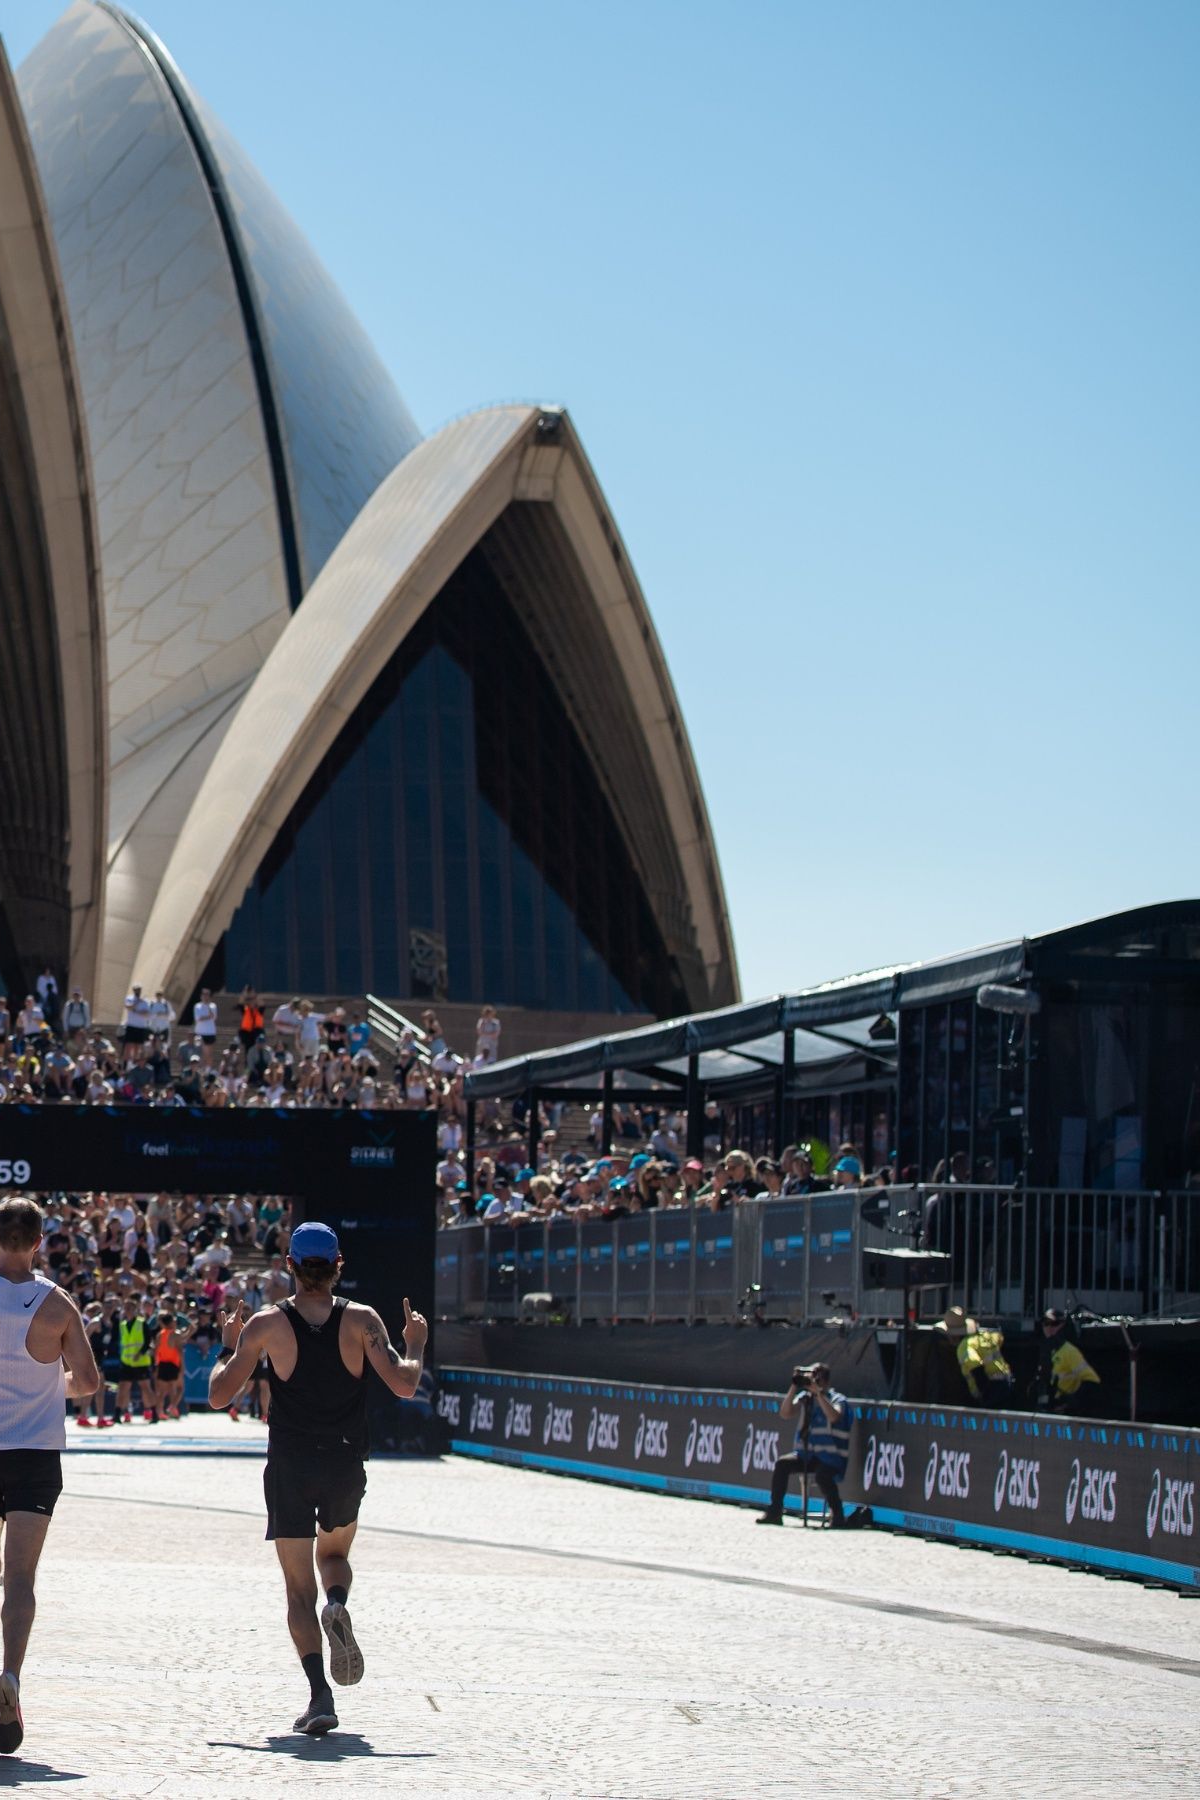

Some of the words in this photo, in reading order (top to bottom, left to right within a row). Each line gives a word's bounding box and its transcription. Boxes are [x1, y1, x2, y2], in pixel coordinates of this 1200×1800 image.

[142, 1142, 169, 1156] feel
[350, 1146, 395, 1159] SYDNEY
[876, 1441, 905, 1488] asics
[938, 1448, 970, 1499] asics
[1008, 1457, 1040, 1510] asics
[1080, 1468, 1117, 1522] asics
[1162, 1478, 1194, 1536] asics
